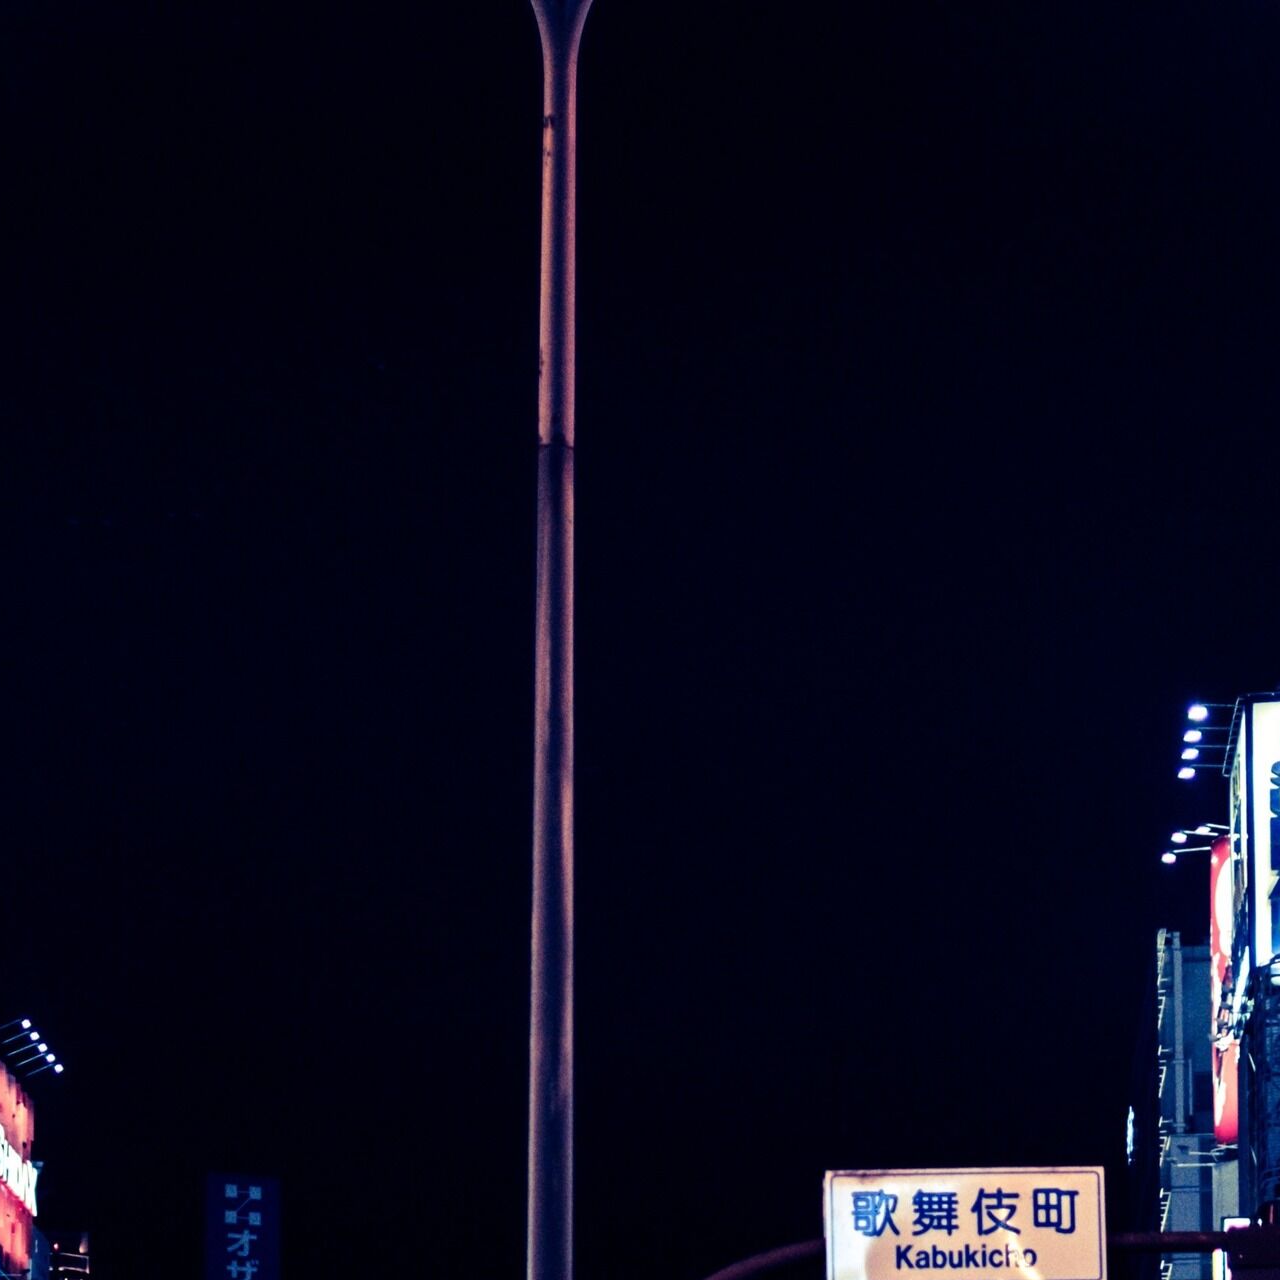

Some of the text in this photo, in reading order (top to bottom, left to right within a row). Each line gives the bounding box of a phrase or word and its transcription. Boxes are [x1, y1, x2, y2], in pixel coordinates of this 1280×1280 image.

[850, 1187, 1080, 1238] 歌舞伎町
[894, 1244, 1038, 1270] Kabukicho
